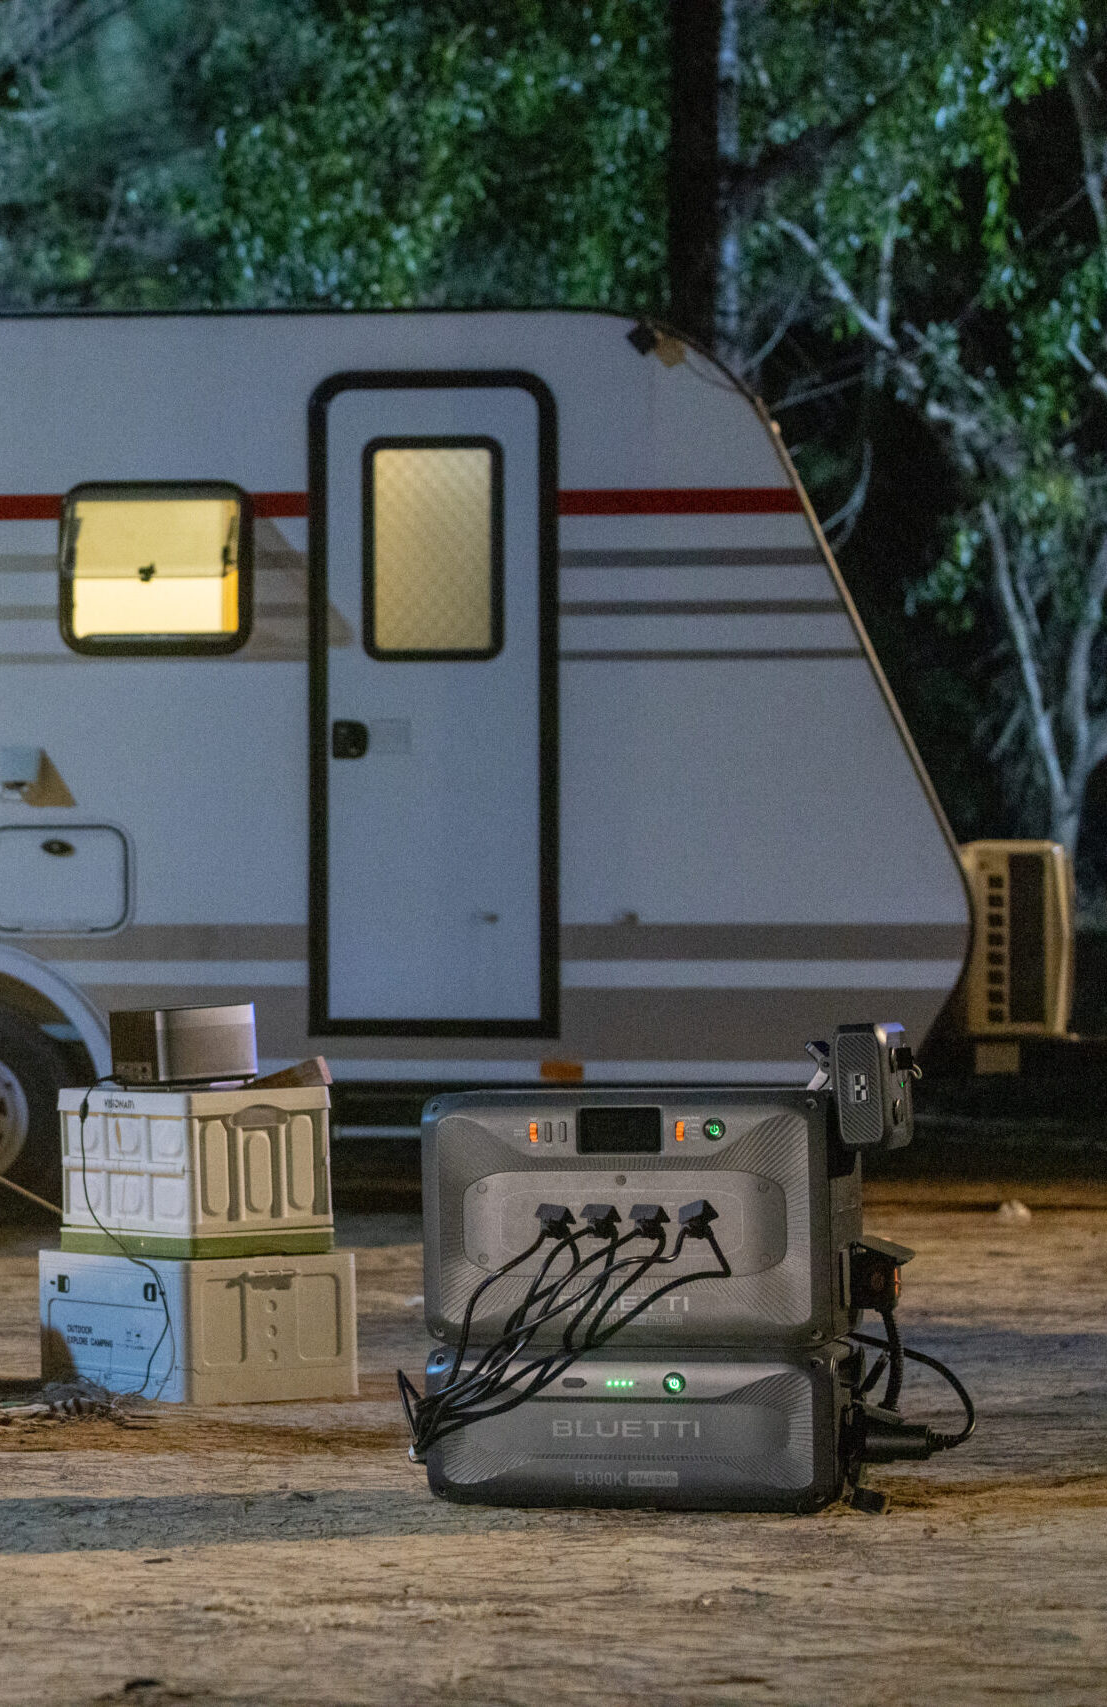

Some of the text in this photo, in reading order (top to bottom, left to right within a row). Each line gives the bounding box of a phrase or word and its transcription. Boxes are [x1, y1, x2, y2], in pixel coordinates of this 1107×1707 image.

[67, 1324, 93, 1335] OUTDOOR
[66, 1336, 89, 1346] EXPLORE
[552, 1420, 700, 1438] BLUETTI
[575, 1471, 624, 1486] B300K
